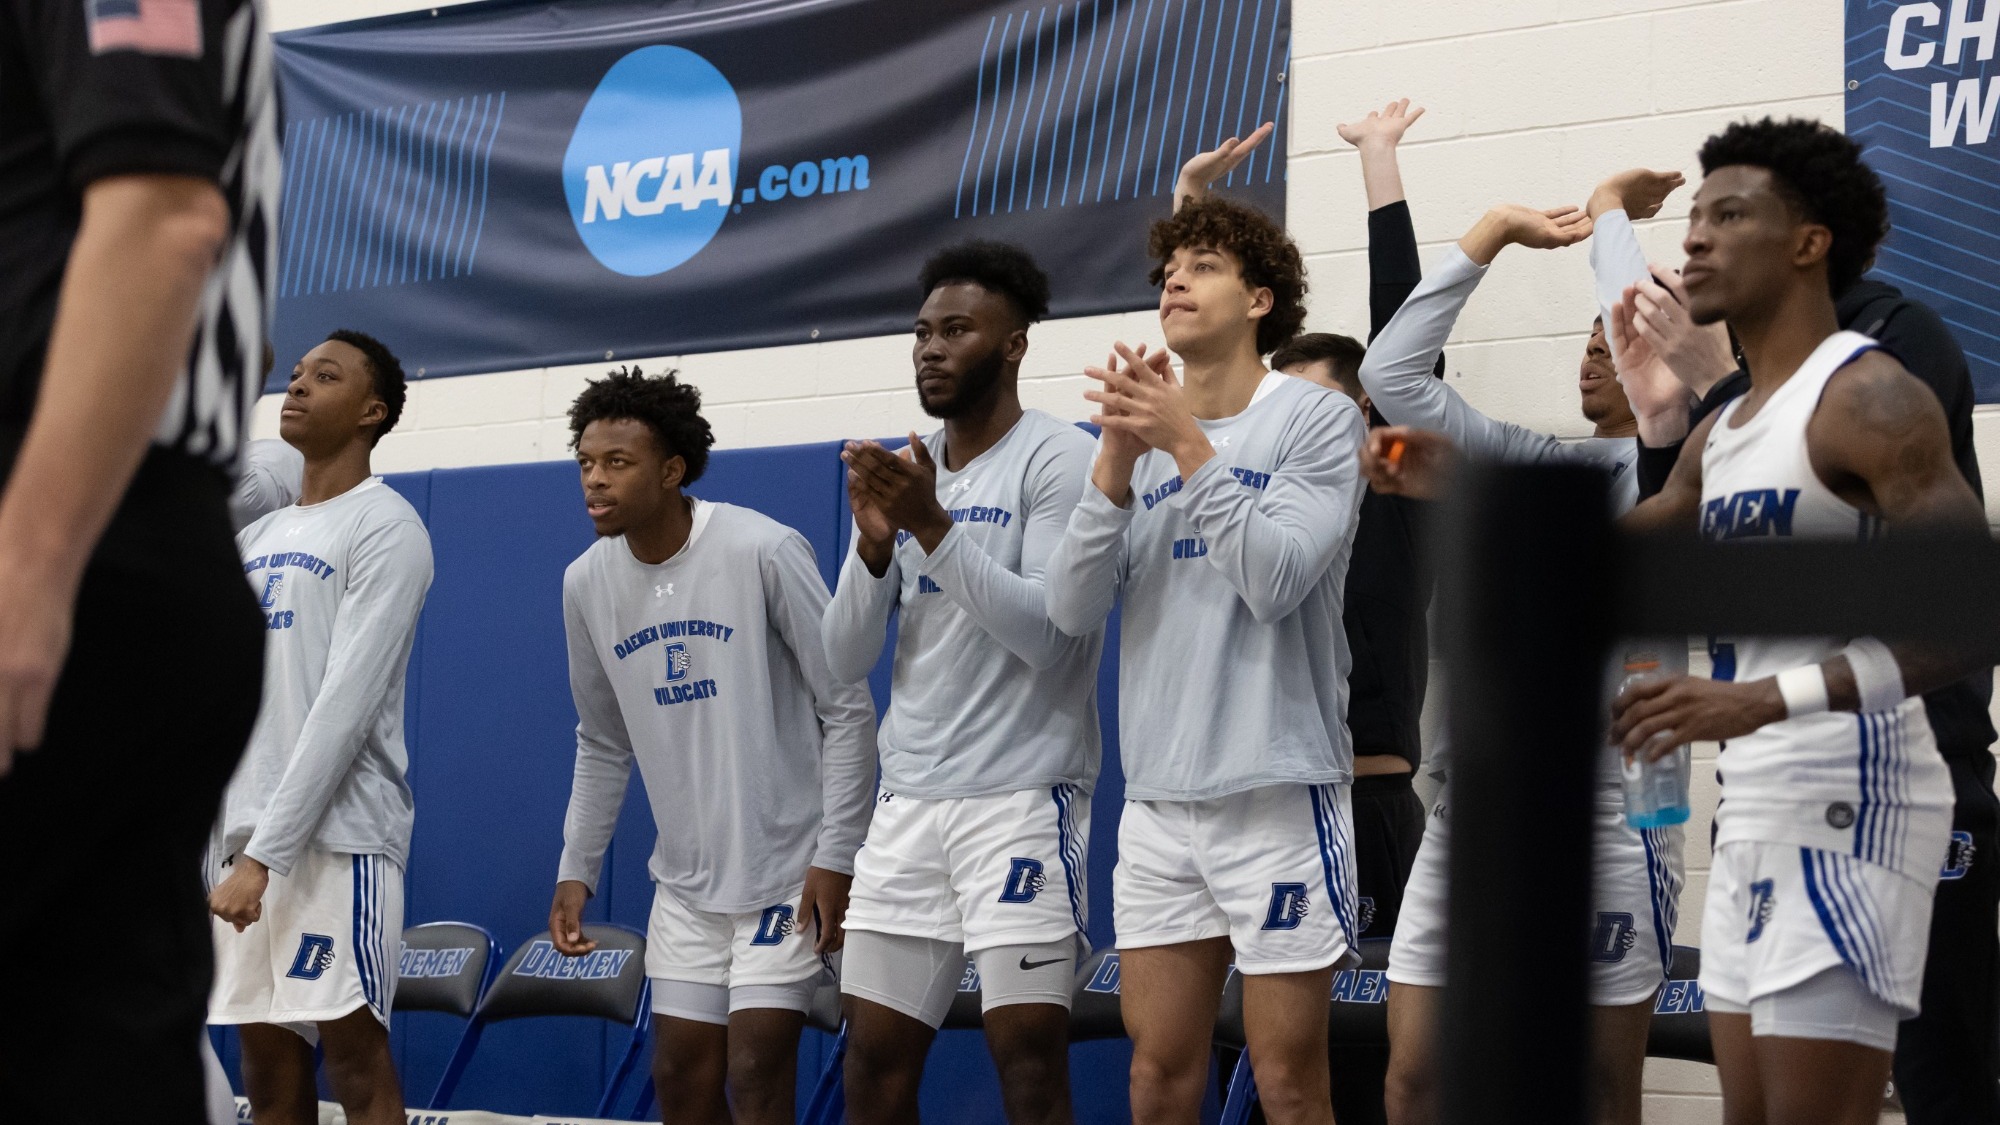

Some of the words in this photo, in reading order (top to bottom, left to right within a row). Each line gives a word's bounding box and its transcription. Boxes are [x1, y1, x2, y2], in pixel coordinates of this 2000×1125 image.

[582, 148, 732, 224] NCAA
[1699, 488, 1801, 540] EMEN
[613, 625, 660, 660] DAEMEN
[659, 620, 734, 643] UNIVERSITY
[653, 679, 717, 706] WILDCATS
[399, 941, 475, 977] AEMEN
[512, 941, 634, 979] DAEMEN
